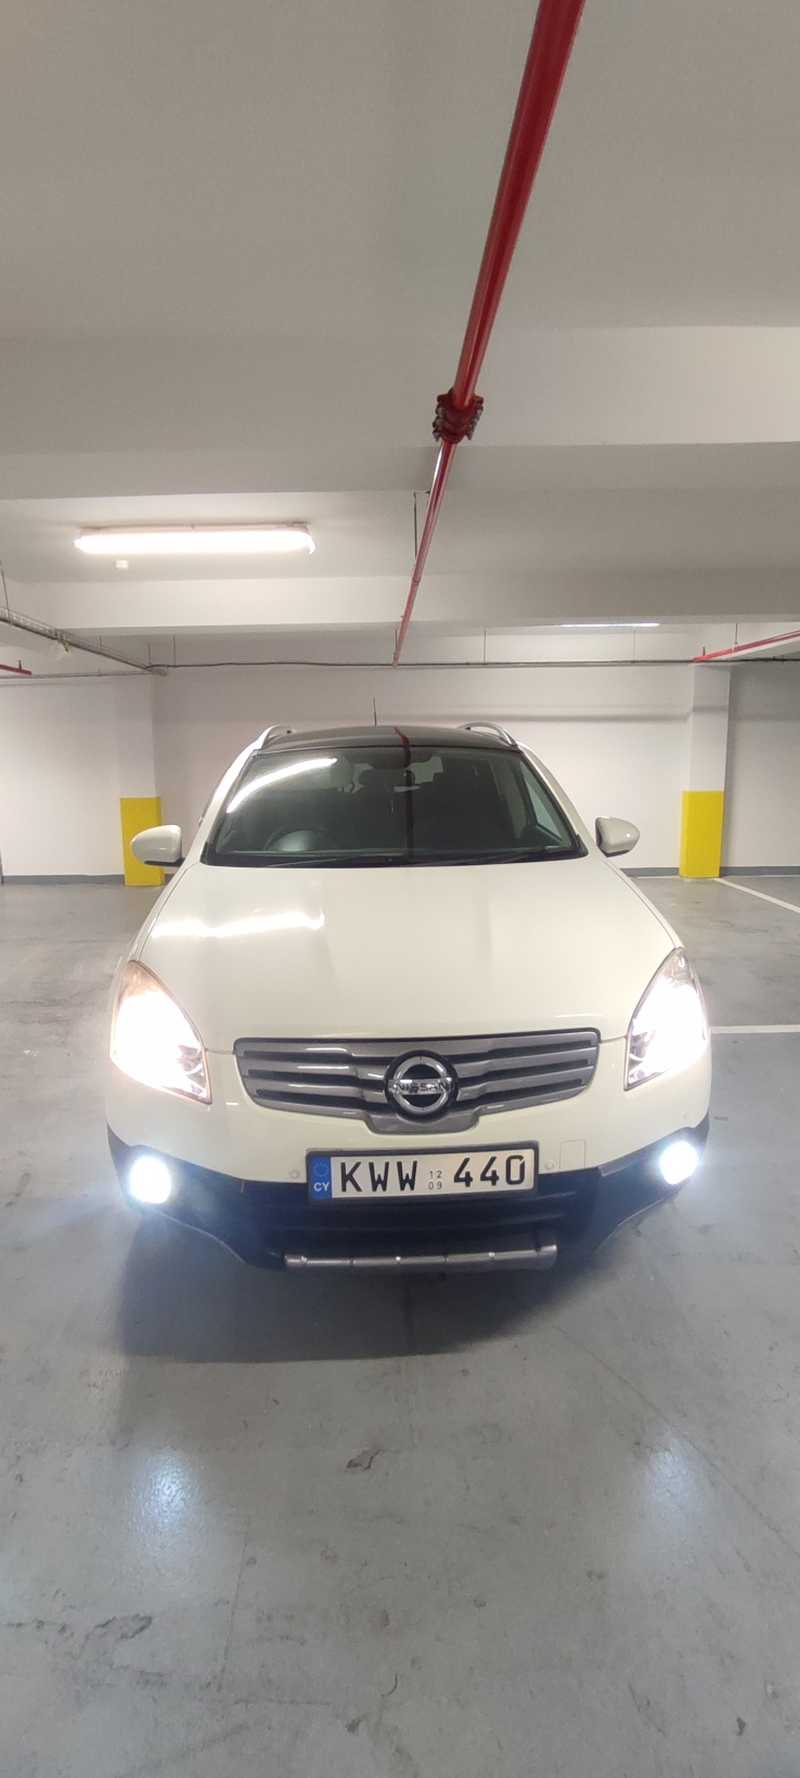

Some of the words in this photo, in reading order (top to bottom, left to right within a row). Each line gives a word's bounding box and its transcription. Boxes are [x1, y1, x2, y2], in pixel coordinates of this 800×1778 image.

[391, 1079, 450, 1094] NISSAN
[340, 1160, 418, 1193] KWW
[453, 1155, 526, 1187] 440
[428, 1170, 443, 1179] 12
[313, 1182, 329, 1192] CY
[427, 1181, 443, 1190] 09
